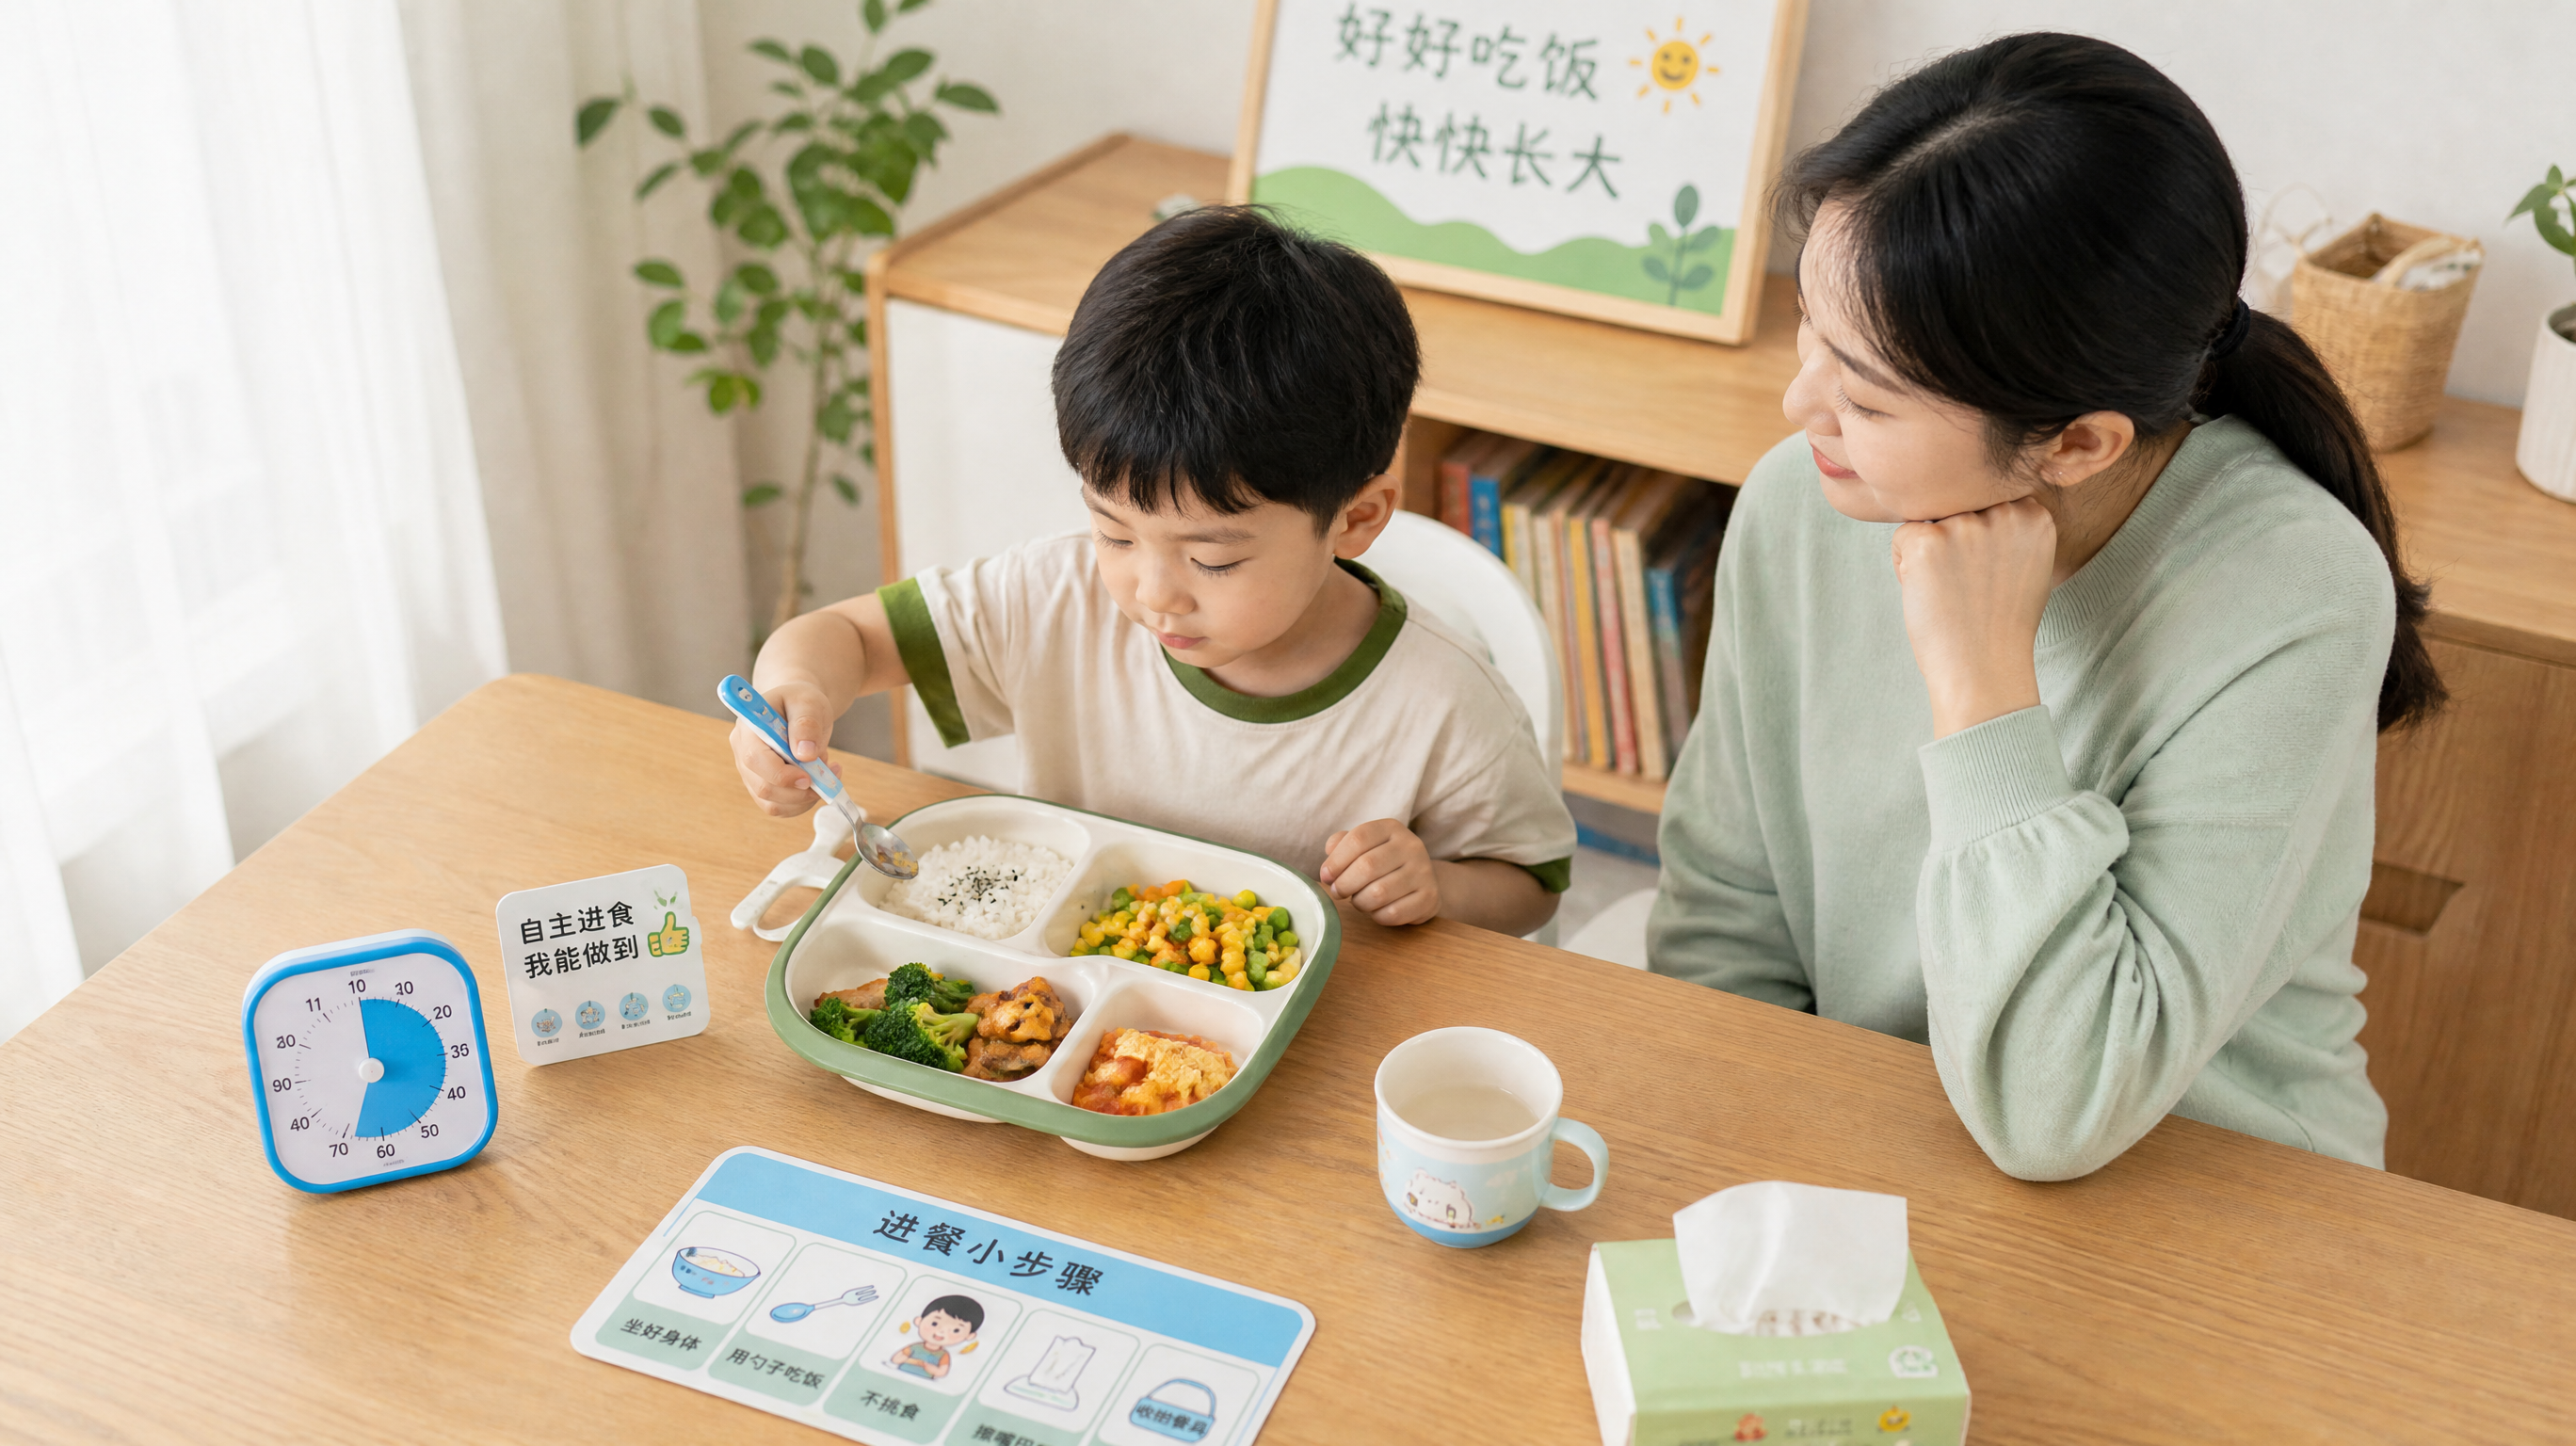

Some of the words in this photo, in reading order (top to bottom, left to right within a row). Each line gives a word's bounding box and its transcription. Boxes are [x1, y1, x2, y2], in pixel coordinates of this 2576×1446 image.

[1333, 2, 1601, 102] 好好吃饭
[1368, 102, 1622, 200] 快快长大
[521, 901, 634, 944] 自主进食
[524, 935, 639, 979] 我能做到
[348, 979, 366, 994] 10
[305, 997, 321, 1012] 11
[433, 1004, 452, 1020] 20
[272, 1078, 292, 1092] 90
[447, 1085, 466, 1101] 40
[421, 1124, 439, 1138] 50
[329, 1142, 348, 1158] 70
[377, 1144, 395, 1159] 60
[873, 1210, 1104, 1296] 进餐小步骤
[620, 1318, 702, 1352] 坐好身体
[726, 1347, 825, 1390] 用勺子吃饭
[860, 1390, 922, 1422] 不挑食
